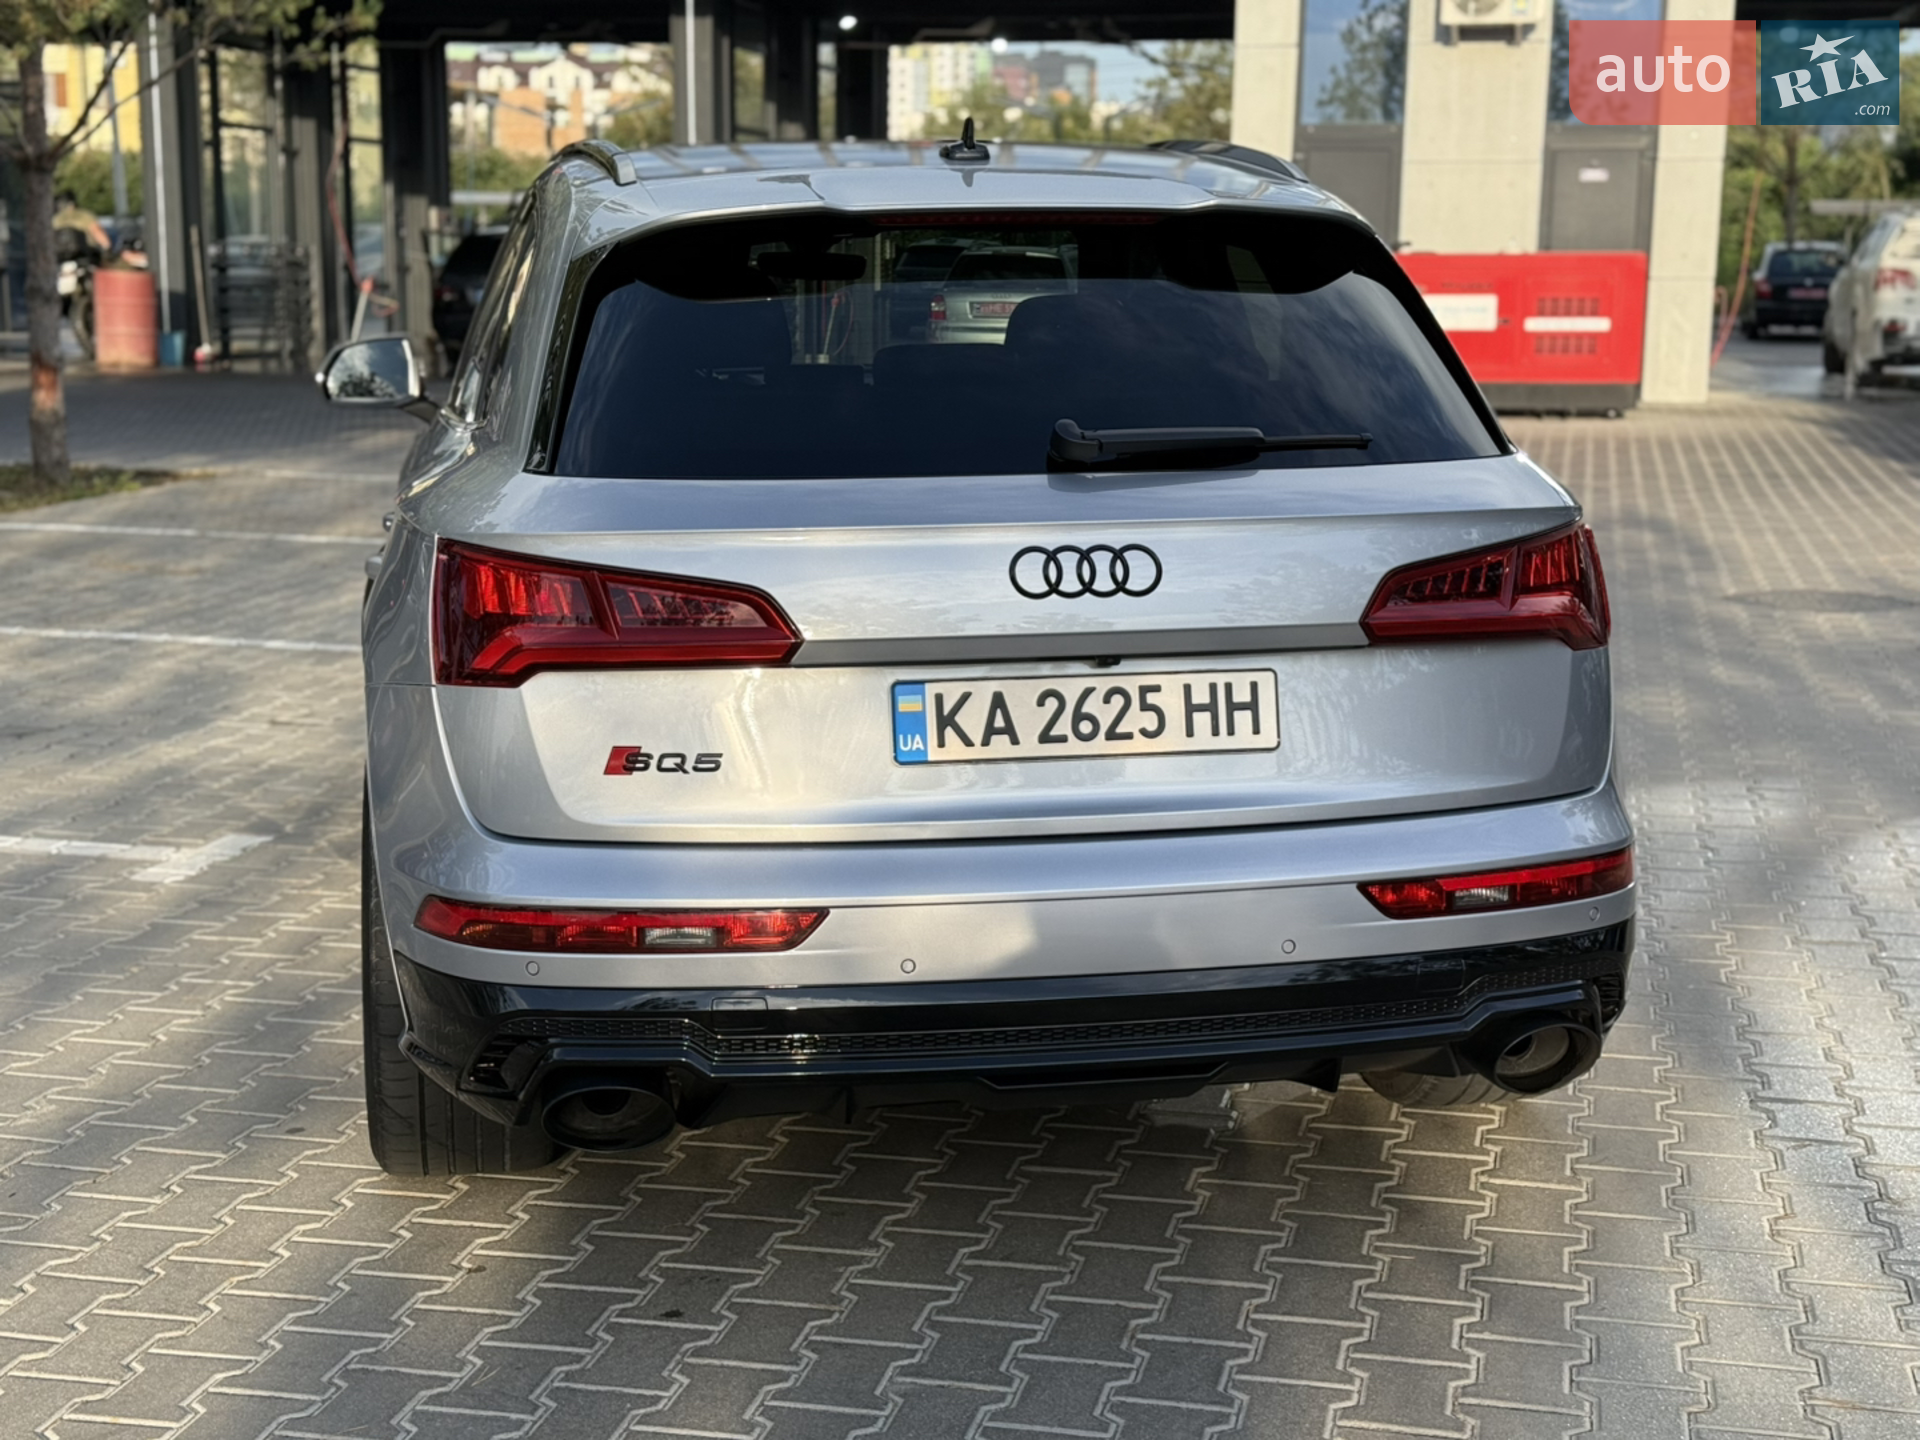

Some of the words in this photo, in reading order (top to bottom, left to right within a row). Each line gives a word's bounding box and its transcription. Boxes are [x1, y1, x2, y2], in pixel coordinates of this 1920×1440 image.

[934, 690, 1021, 749] KA
[1035, 684, 1167, 745] 2625
[1182, 680, 1262, 738] HH
[899, 733, 925, 752] UA
[621, 752, 724, 775] SQ5
